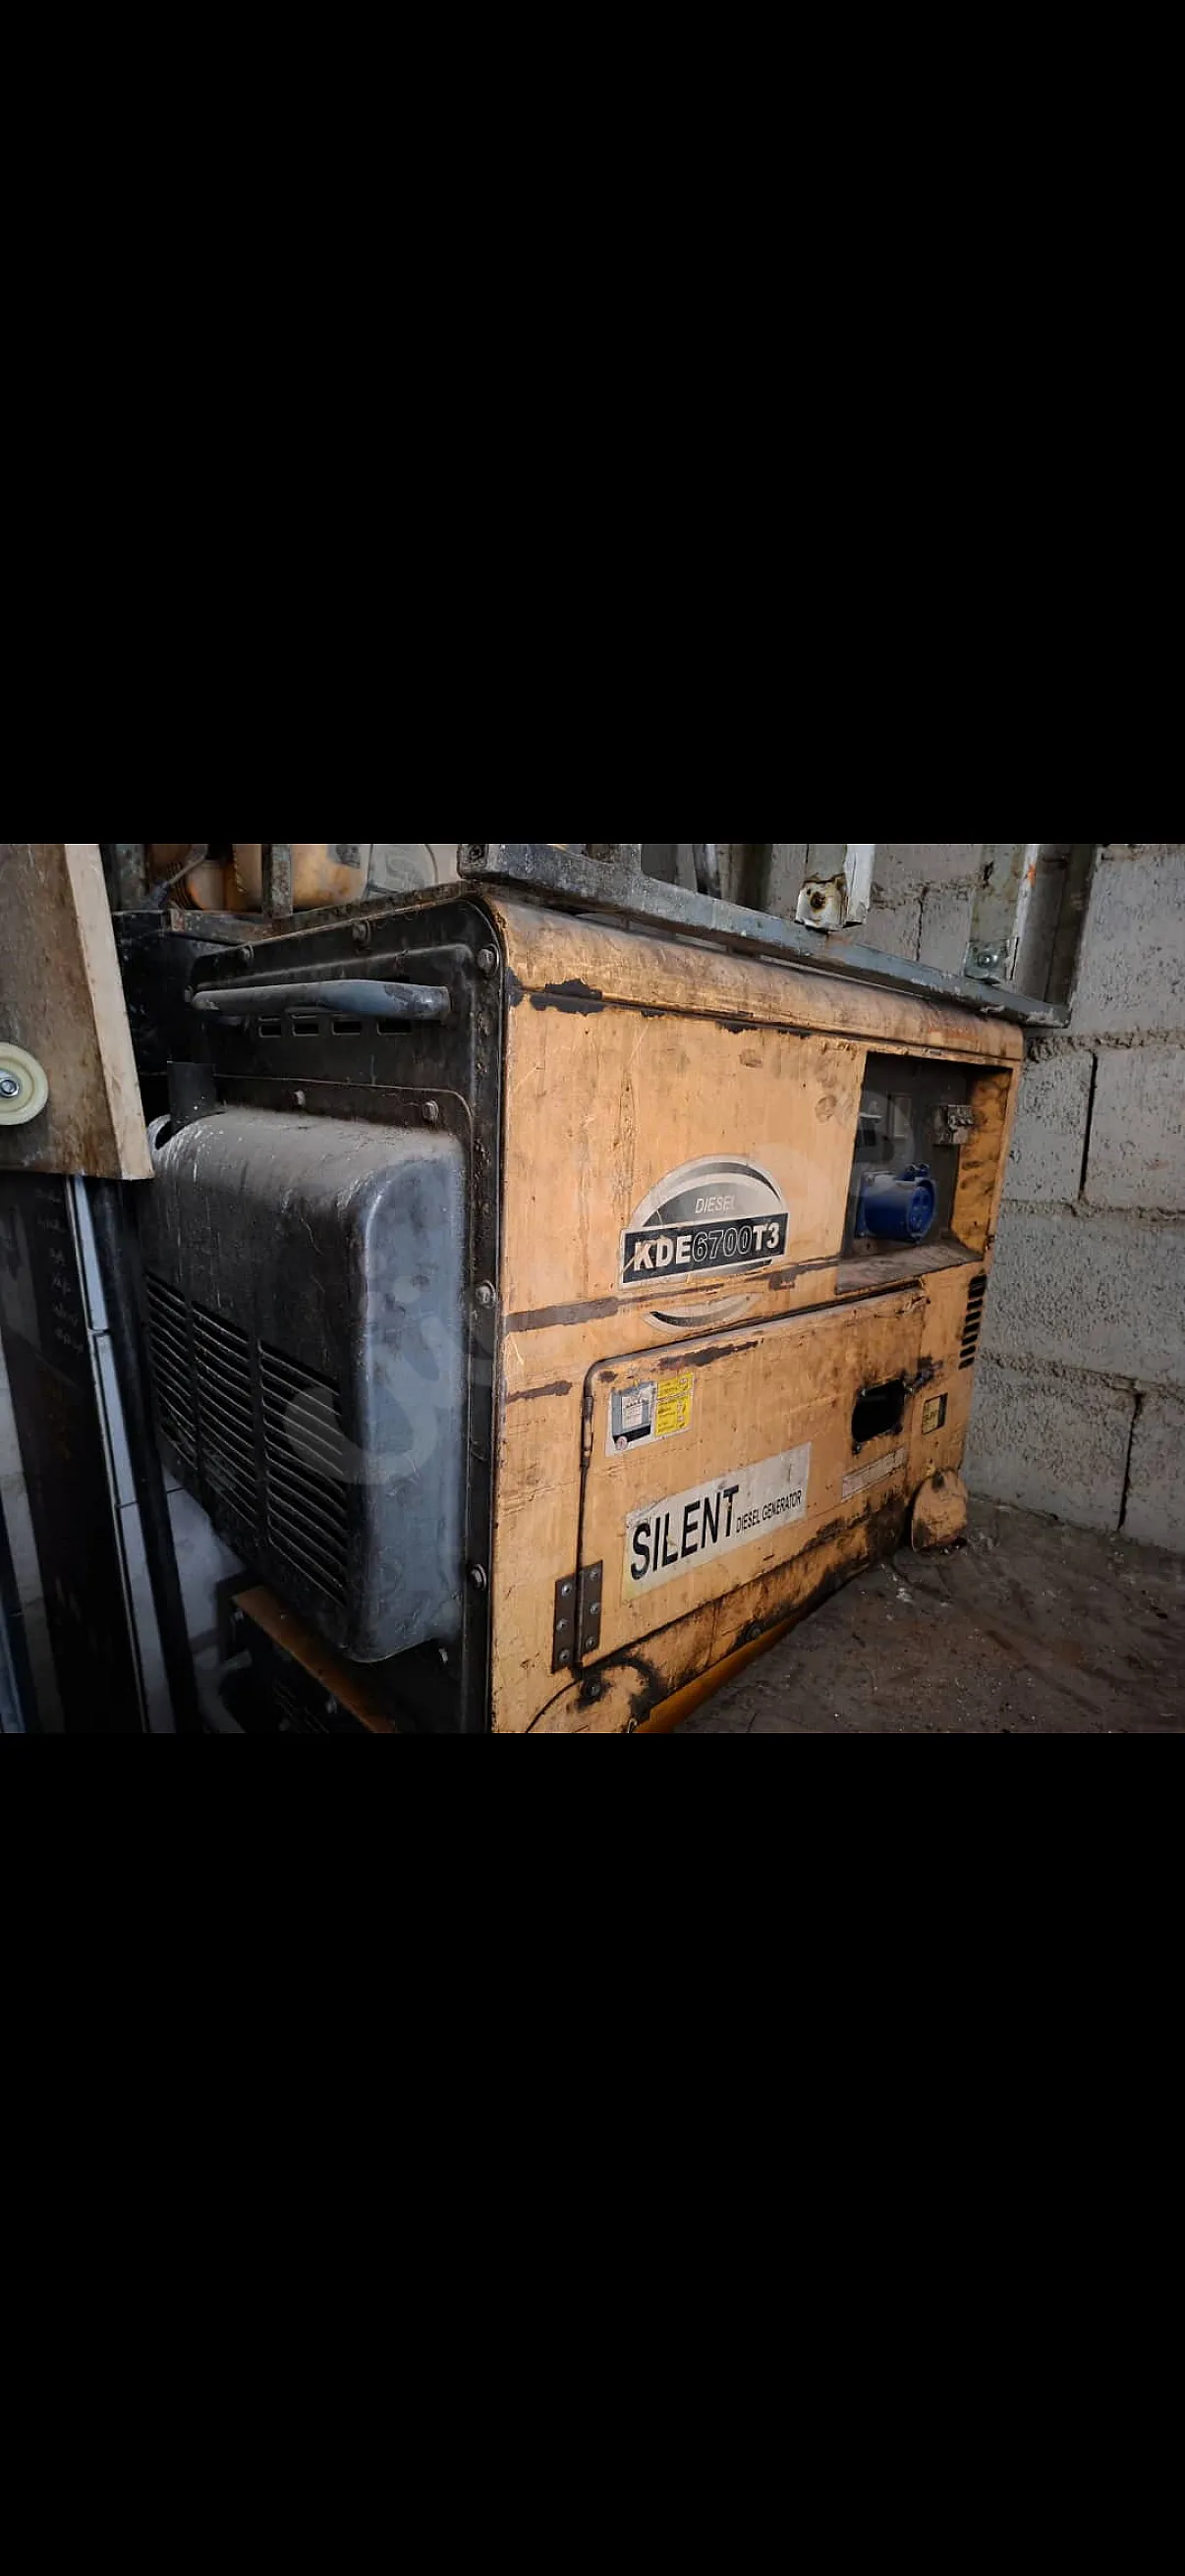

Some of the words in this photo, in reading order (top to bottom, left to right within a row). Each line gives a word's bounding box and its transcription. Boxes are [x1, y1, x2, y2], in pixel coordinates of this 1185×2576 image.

[695, 1195, 737, 1214] DIESEL
[633, 1222, 780, 1271] KDE6700T3
[630, 1484, 739, 1581] SILENT
[736, 1509, 761, 1534] DIESEL
[762, 1489, 802, 1521] GENERATOR
